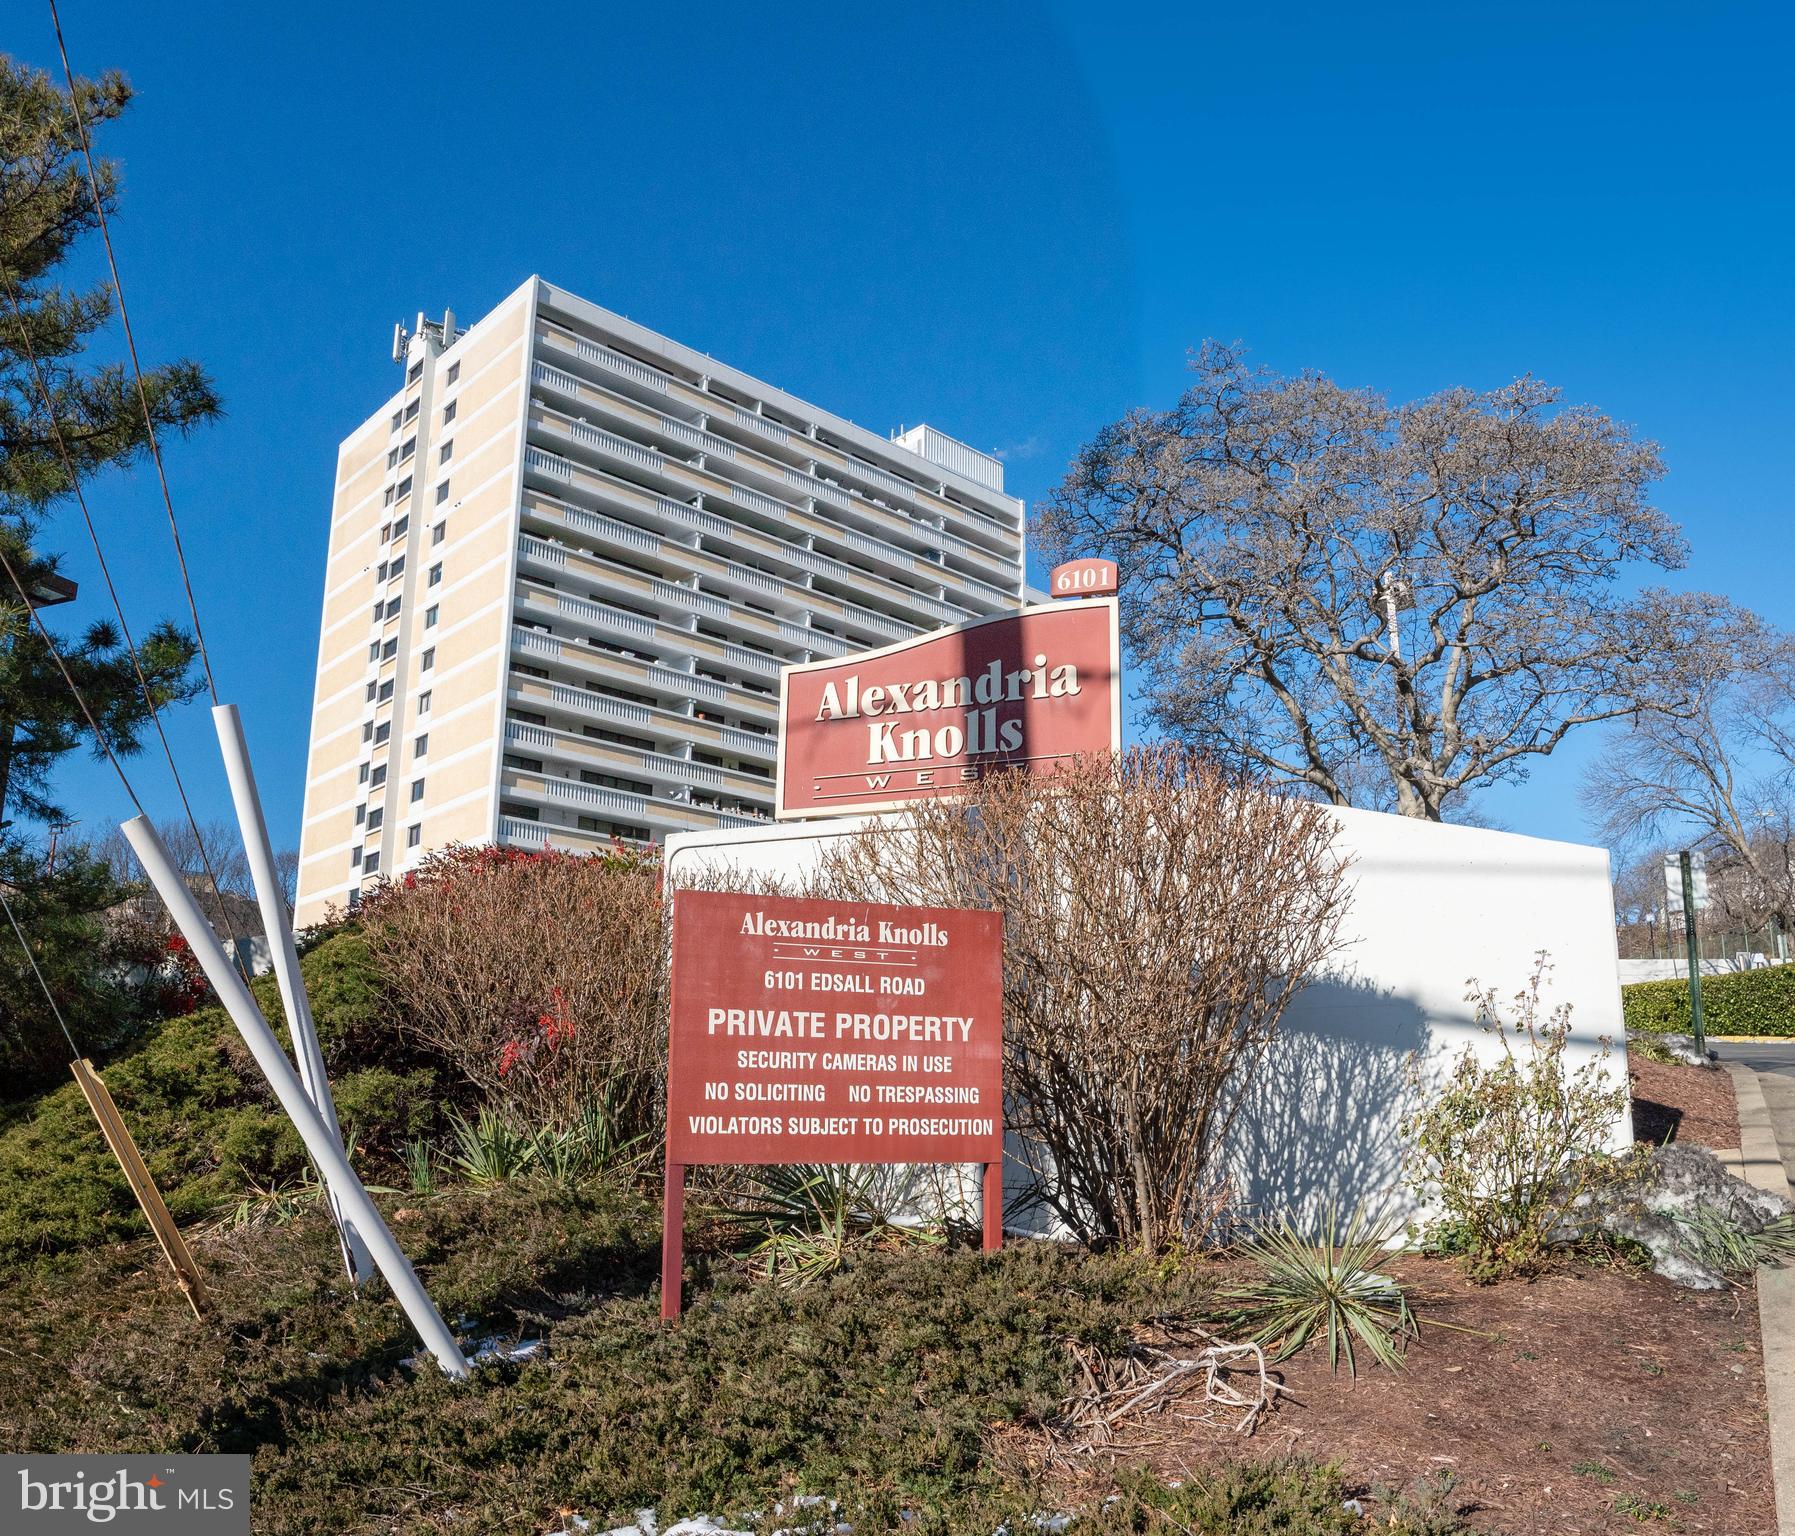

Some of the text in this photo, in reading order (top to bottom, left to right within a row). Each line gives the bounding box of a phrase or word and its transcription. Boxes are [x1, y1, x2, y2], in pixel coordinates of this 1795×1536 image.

[1057, 566, 1109, 591] 6101
[815, 654, 1082, 722] Alexandria
[866, 707, 1024, 765] Knolls
[740, 912, 948, 947] Alexandria Knolls
[803, 948, 889, 960] WEST
[764, 970, 925, 996] 6101 EDSALL ROAD
[708, 1008, 974, 1042] PRIVATE PROPERTY
[737, 1050, 952, 1073] SECURITY CAMERAS IN USE
[705, 1082, 980, 1104] NO SOLICITING NO TRESPASSING
[689, 1116, 993, 1136] VIOLATORS SUBJECT TO PROSECUTION
